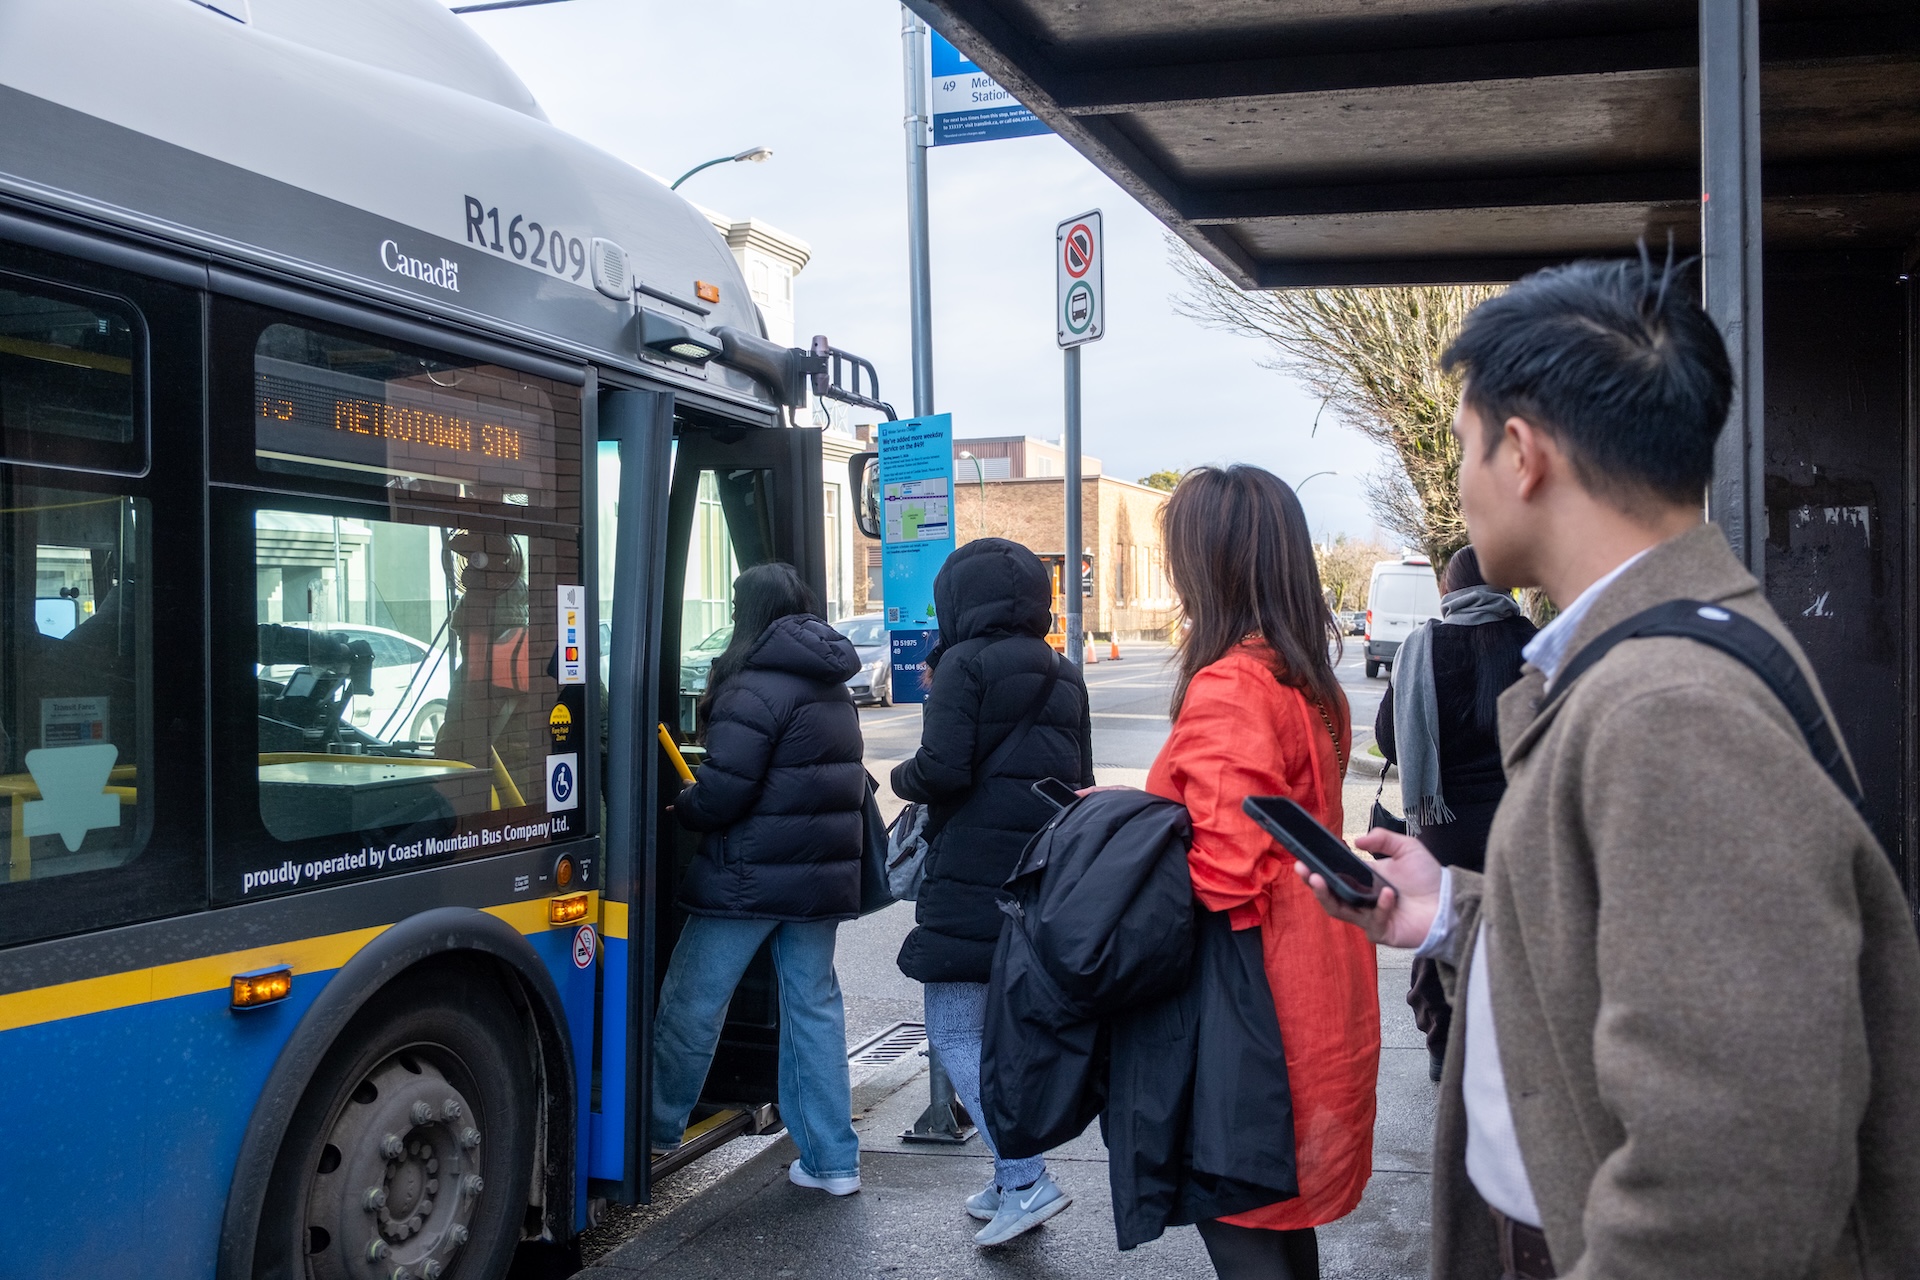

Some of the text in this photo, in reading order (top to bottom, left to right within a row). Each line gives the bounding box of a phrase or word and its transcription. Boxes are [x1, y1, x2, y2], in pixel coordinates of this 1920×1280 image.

[943, 80, 956, 92] 49
[972, 90, 1010, 102] Station
[380, 239, 460, 293] Canada
[464, 194, 586, 282] R16209
[336, 398, 519, 460] METROTOWN STN
[243, 816, 570, 894] proudly operated by Coast Mountain Bus Company Ltd.
